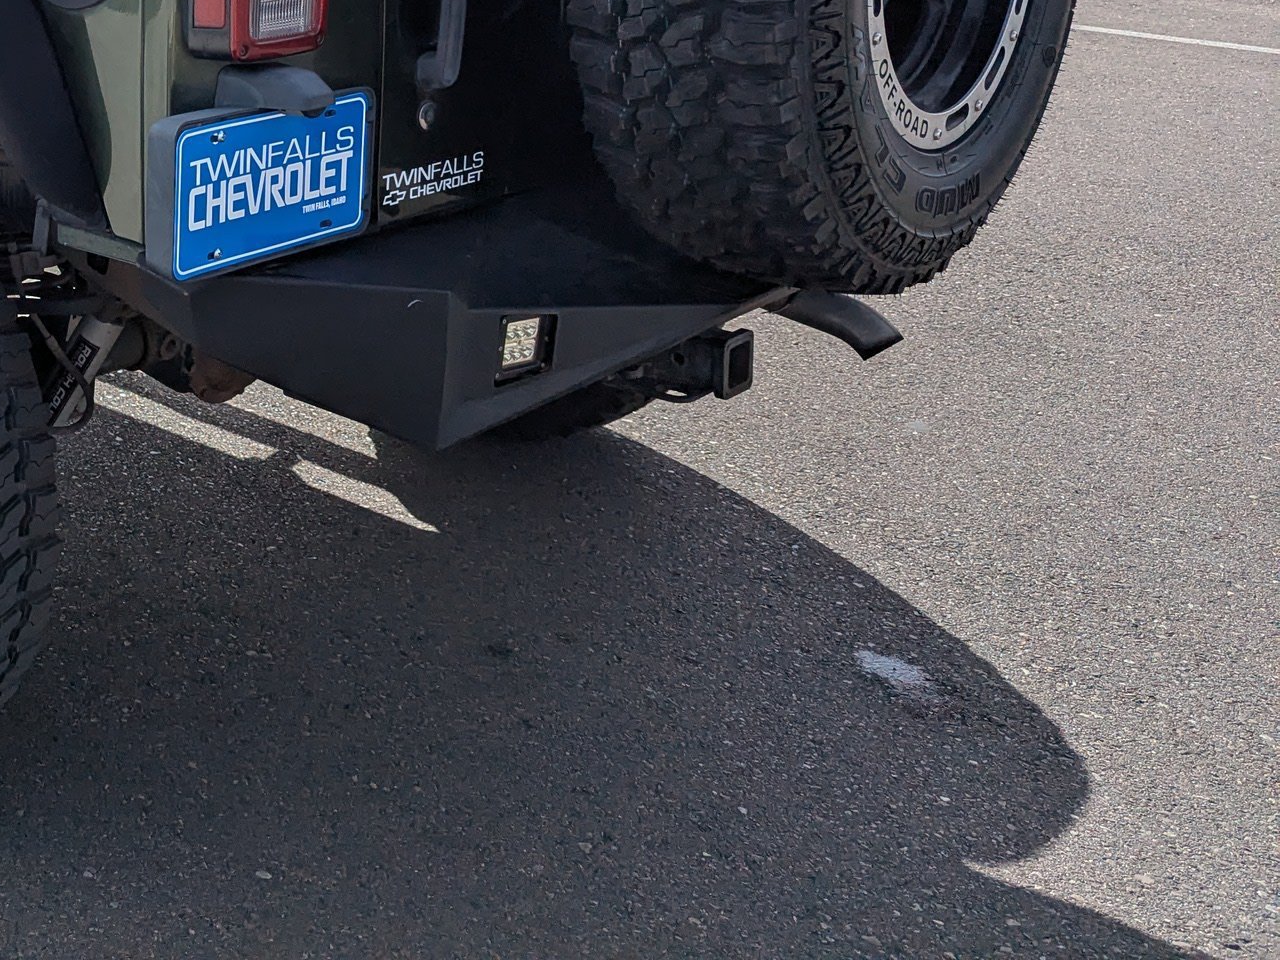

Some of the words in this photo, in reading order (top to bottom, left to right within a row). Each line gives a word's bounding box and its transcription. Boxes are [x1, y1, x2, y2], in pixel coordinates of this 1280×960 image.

[879, 58, 929, 139] OFF-ROAD
[190, 126, 354, 186] TWINFALLS
[383, 151, 485, 191] TWINFALLS
[409, 169, 484, 199] CHEVROLET
[188, 150, 354, 232] CHEVROLET
